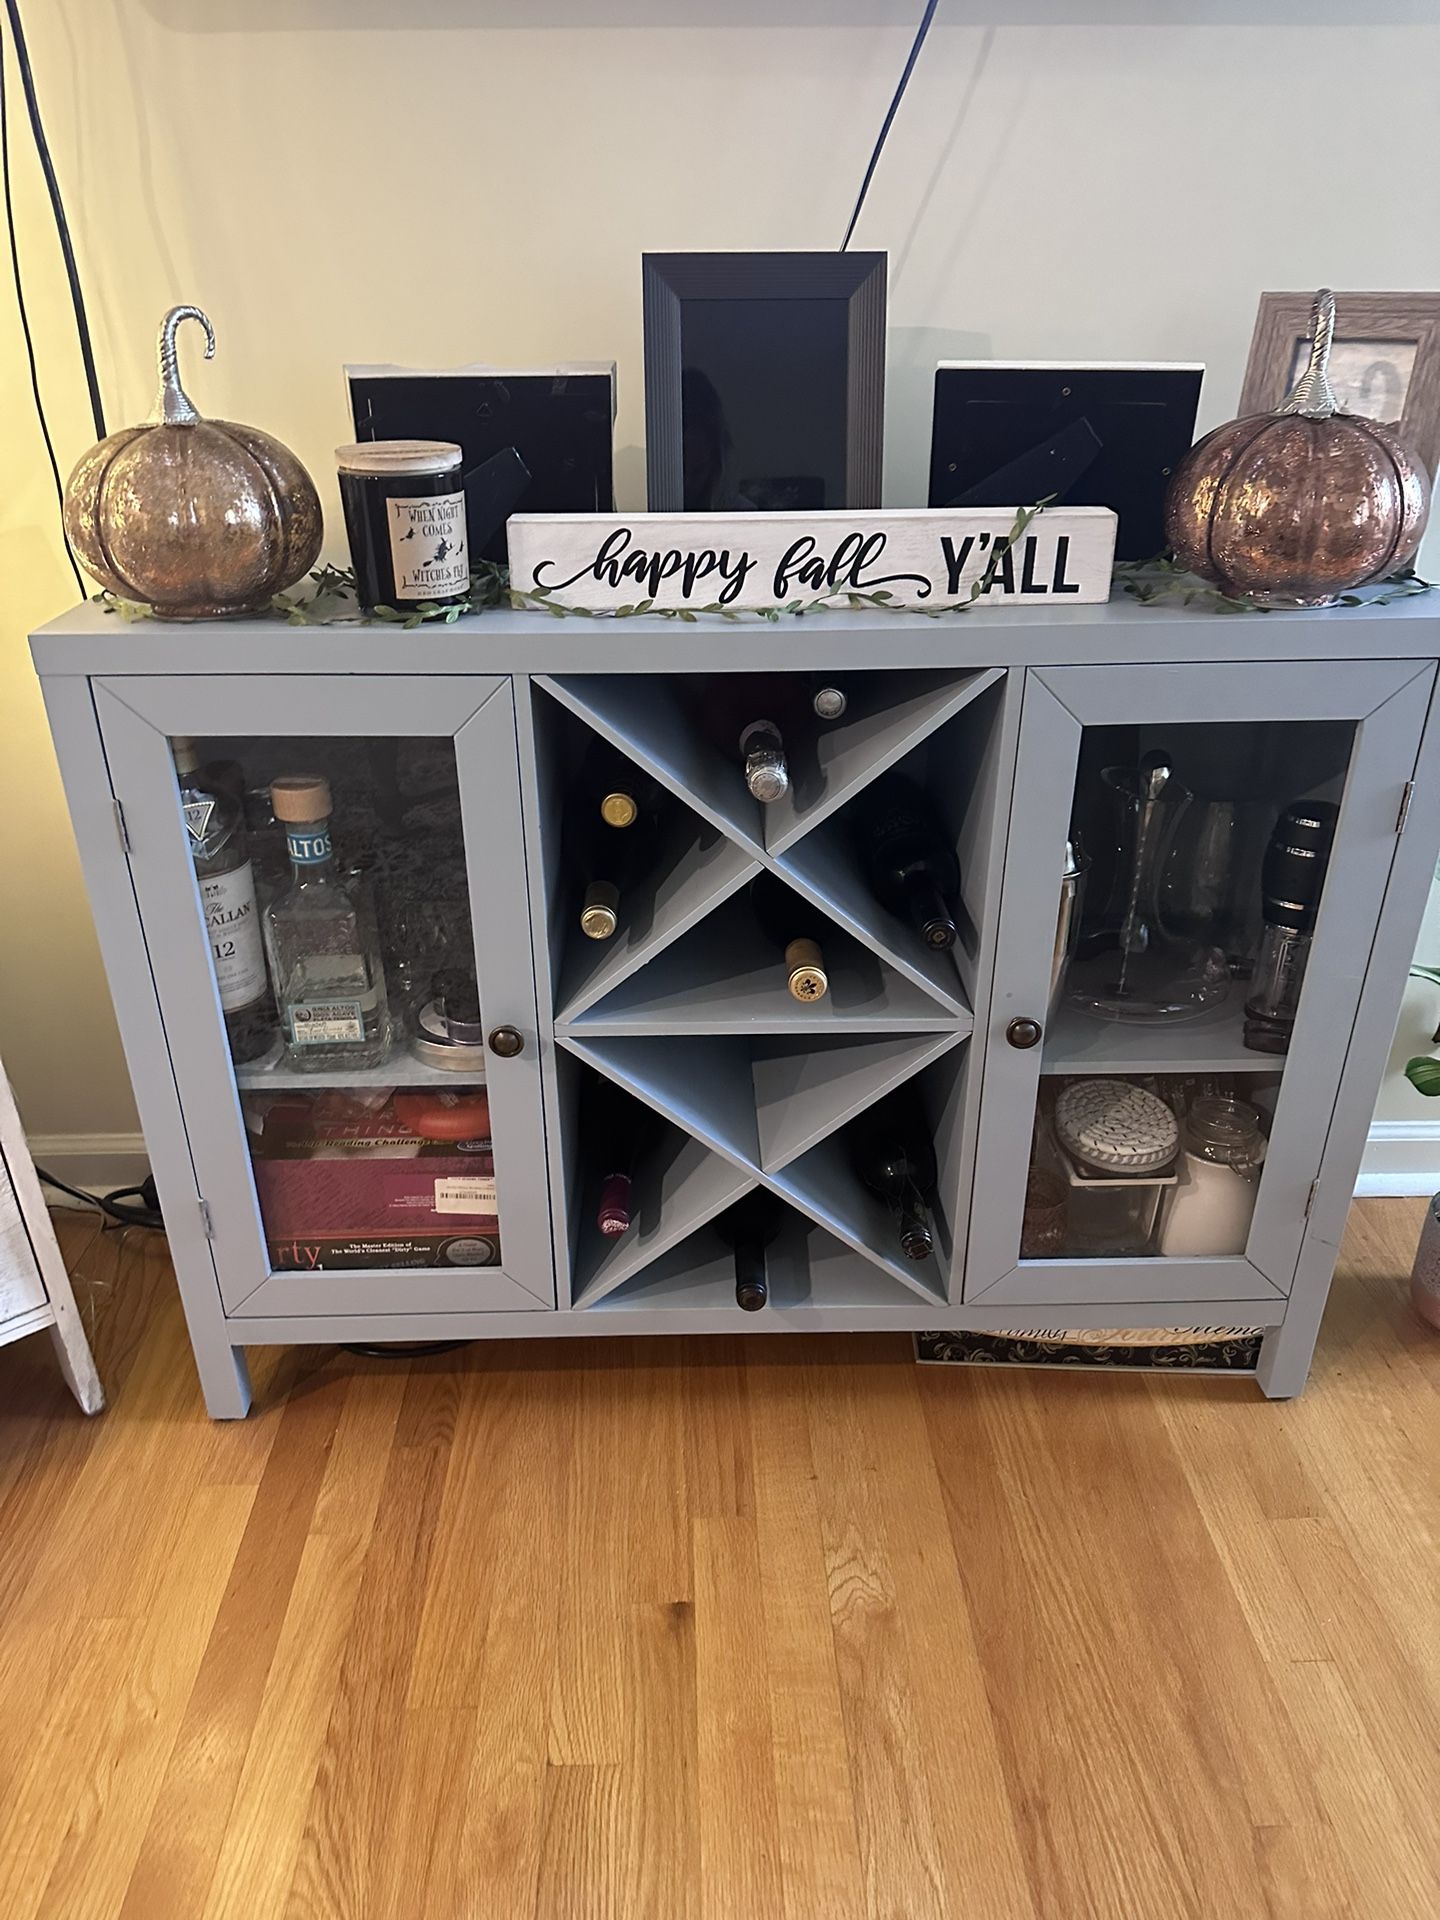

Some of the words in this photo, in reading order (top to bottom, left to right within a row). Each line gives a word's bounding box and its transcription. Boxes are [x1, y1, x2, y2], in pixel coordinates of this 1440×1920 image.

[408, 507, 435, 523] WHEN
[437, 505, 458, 521] NIGHT
[422, 523, 453, 537] COMES
[533, 528, 758, 604] happy
[774, 532, 932, 599] fall
[940, 532, 1080, 595] Y'ALL
[412, 567, 452, 582] WITCHES
[187, 809, 202, 821] 12
[206, 903, 224, 915] The
[213, 941, 236, 959] 12
